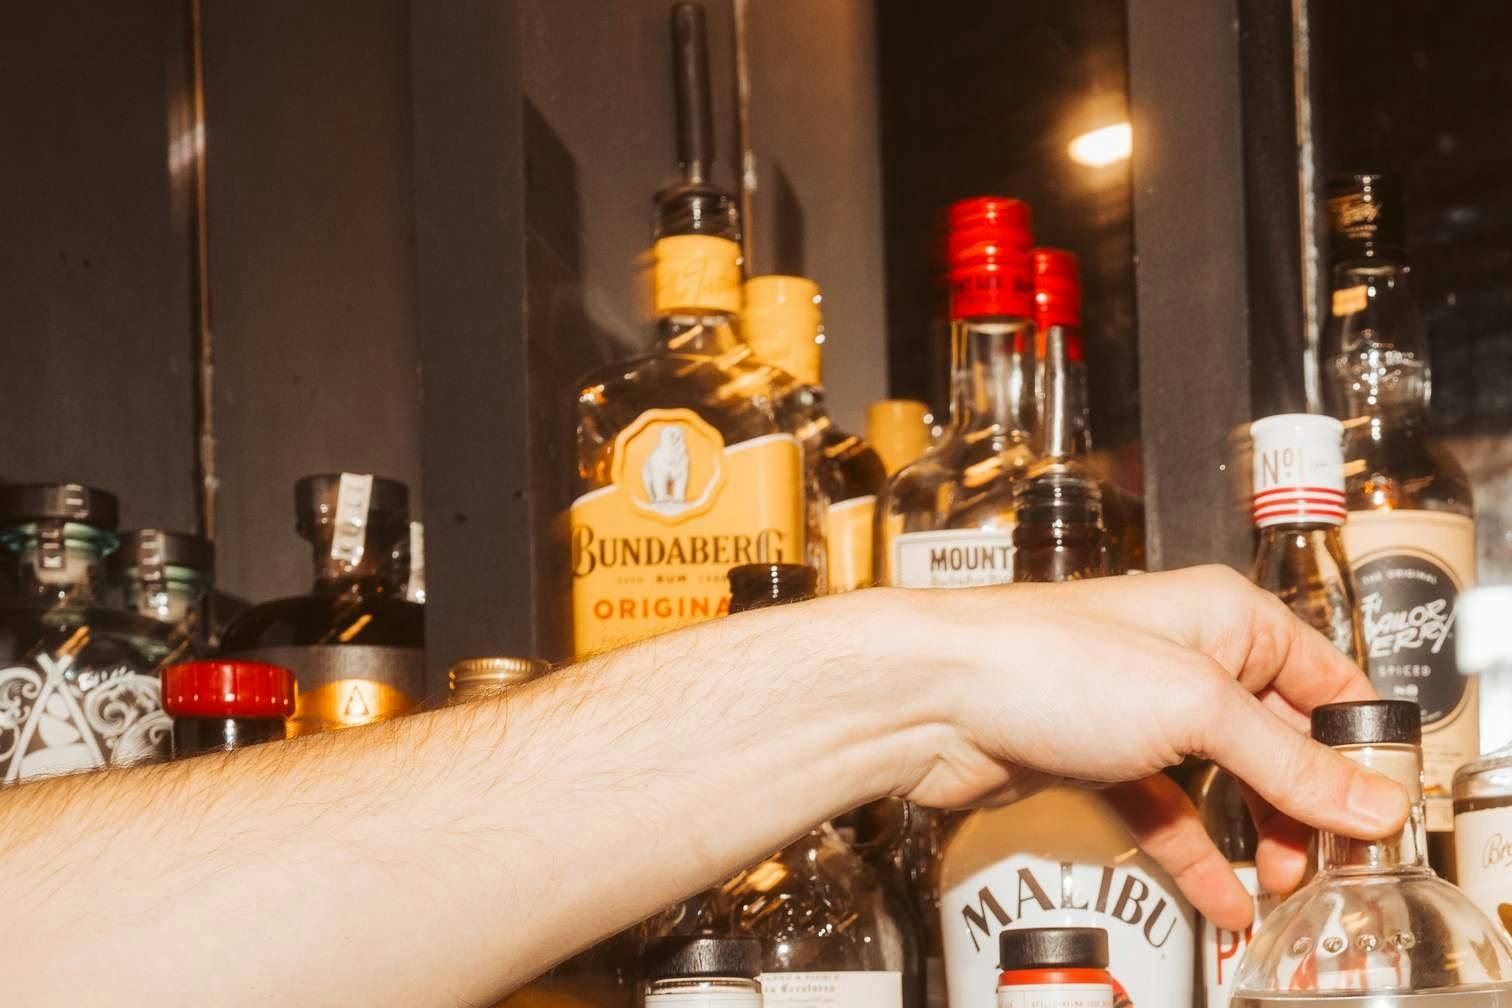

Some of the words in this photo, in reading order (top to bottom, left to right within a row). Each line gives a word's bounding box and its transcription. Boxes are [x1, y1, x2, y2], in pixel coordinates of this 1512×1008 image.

[573, 523, 785, 578] BUNDABERG
[930, 546, 1013, 573] MOUNT
[593, 594, 732, 621] ORIGINA
[960, 861, 1178, 953] MALIBU
